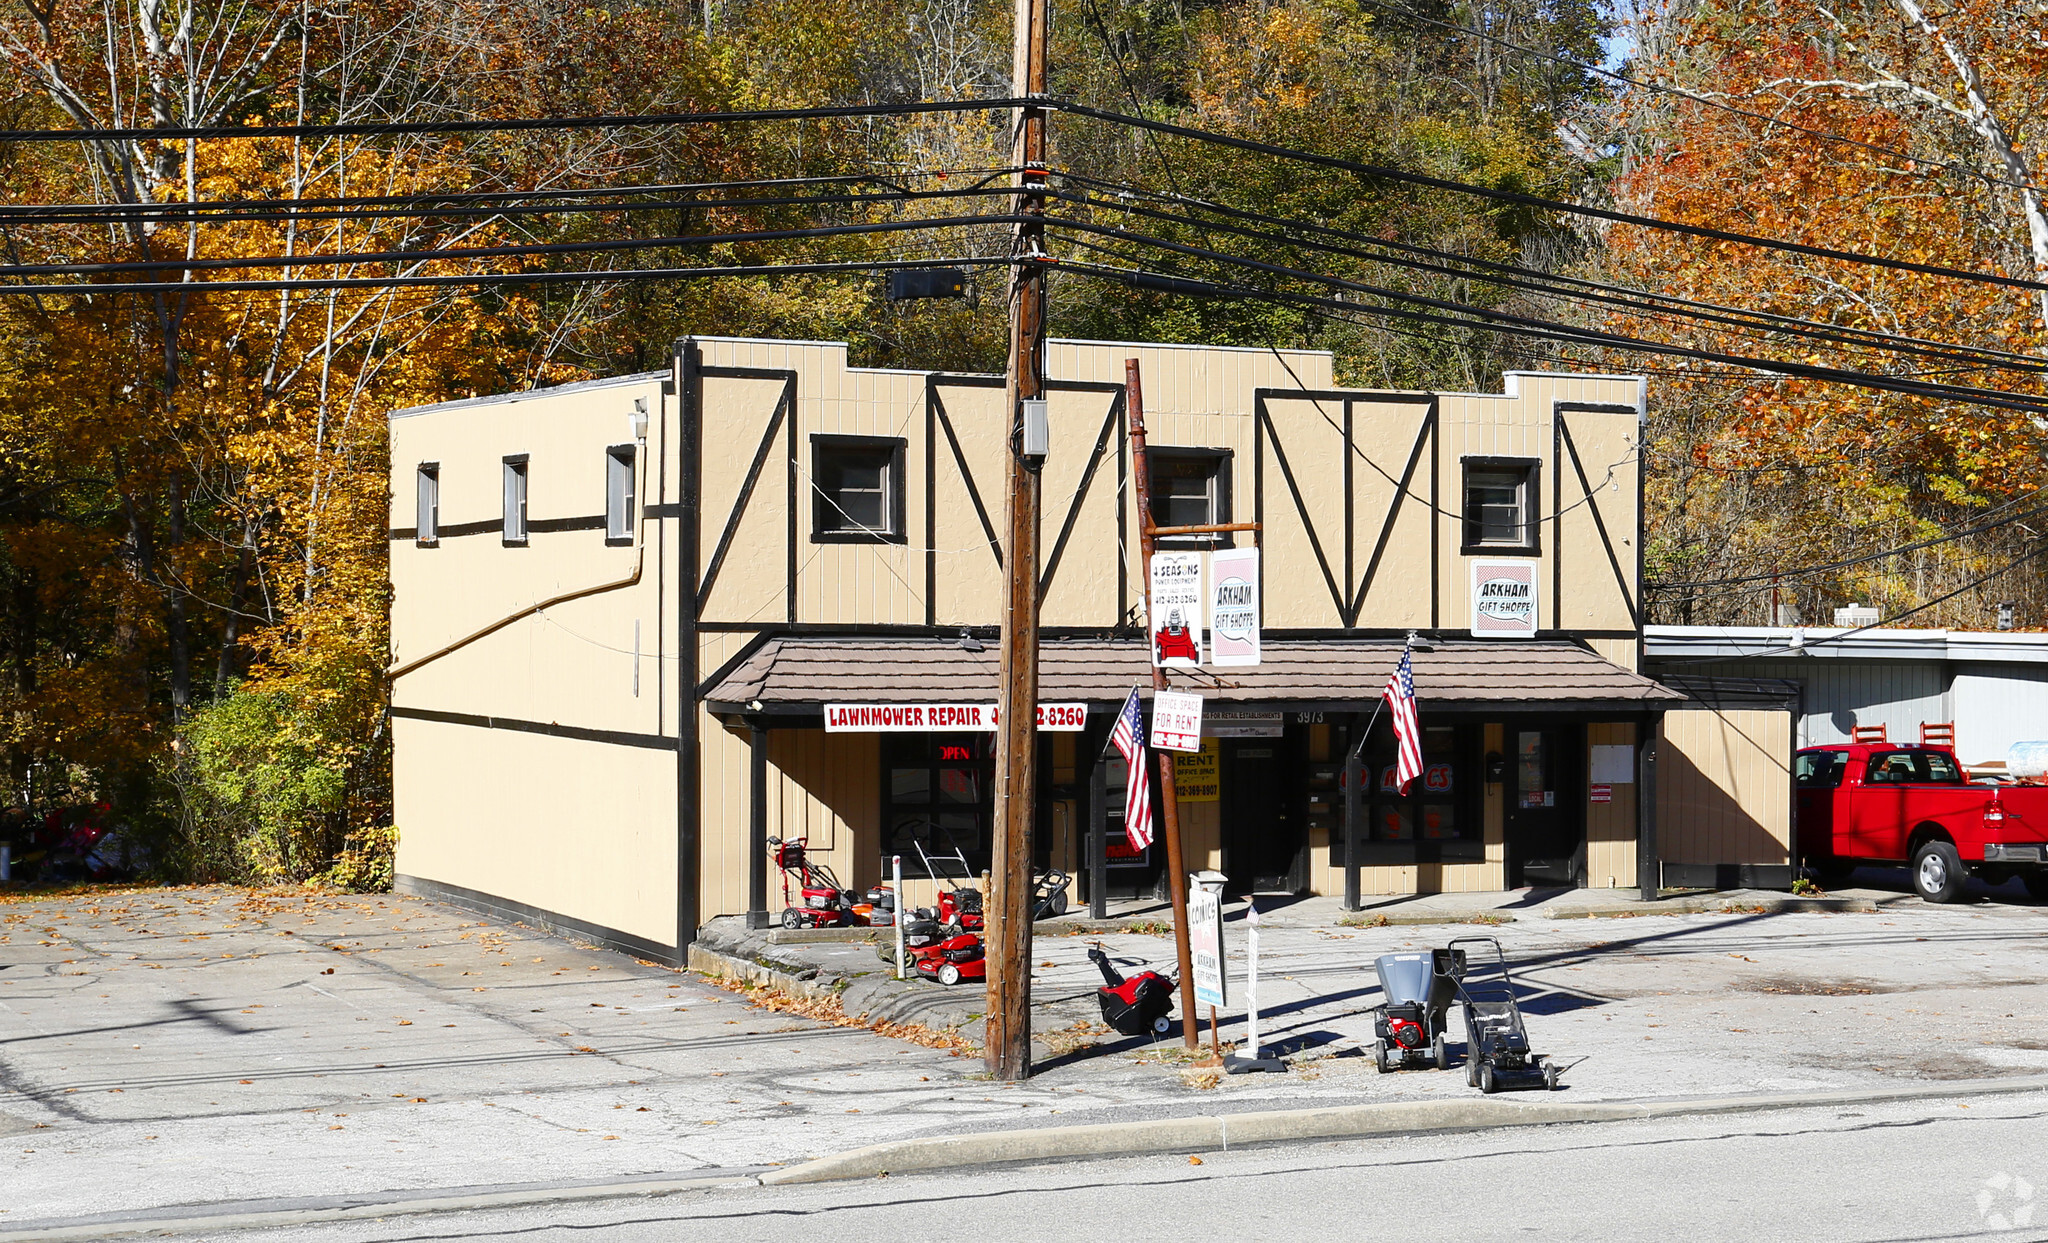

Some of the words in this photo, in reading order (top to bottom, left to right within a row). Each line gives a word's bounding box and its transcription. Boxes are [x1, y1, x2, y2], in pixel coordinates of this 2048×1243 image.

[1153, 566, 1158, 577] 4
[1161, 564, 1198, 577] SEASONS
[1171, 577, 1197, 585] EQUIPMENT
[1217, 585, 1252, 607] ARKHAM
[1482, 583, 1528, 597] ARKHAM
[1478, 601, 1497, 611] GIFT
[1500, 602, 1531, 612] SHOPPE
[1215, 613, 1229, 629] GIFT
[1231, 612, 1253, 628] SHOPPE
[1157, 697, 1177, 710] OFFICE
[1180, 699, 1199, 712] SPACE
[829, 707, 924, 727] LAWNMOWER
[928, 707, 981, 726] REPAIR
[1156, 712, 1172, 728] FOR
[1175, 714, 1198, 731] RENT
[1210, 712, 1221, 720] FOR
[1221, 712, 1239, 720] RETAIL
[1239, 711, 1281, 719] ESTABLISHMENTS
[1297, 711, 1324, 724] 3973
[1177, 755, 1215, 766] RENT
[1192, 901, 1216, 925] COMICS
